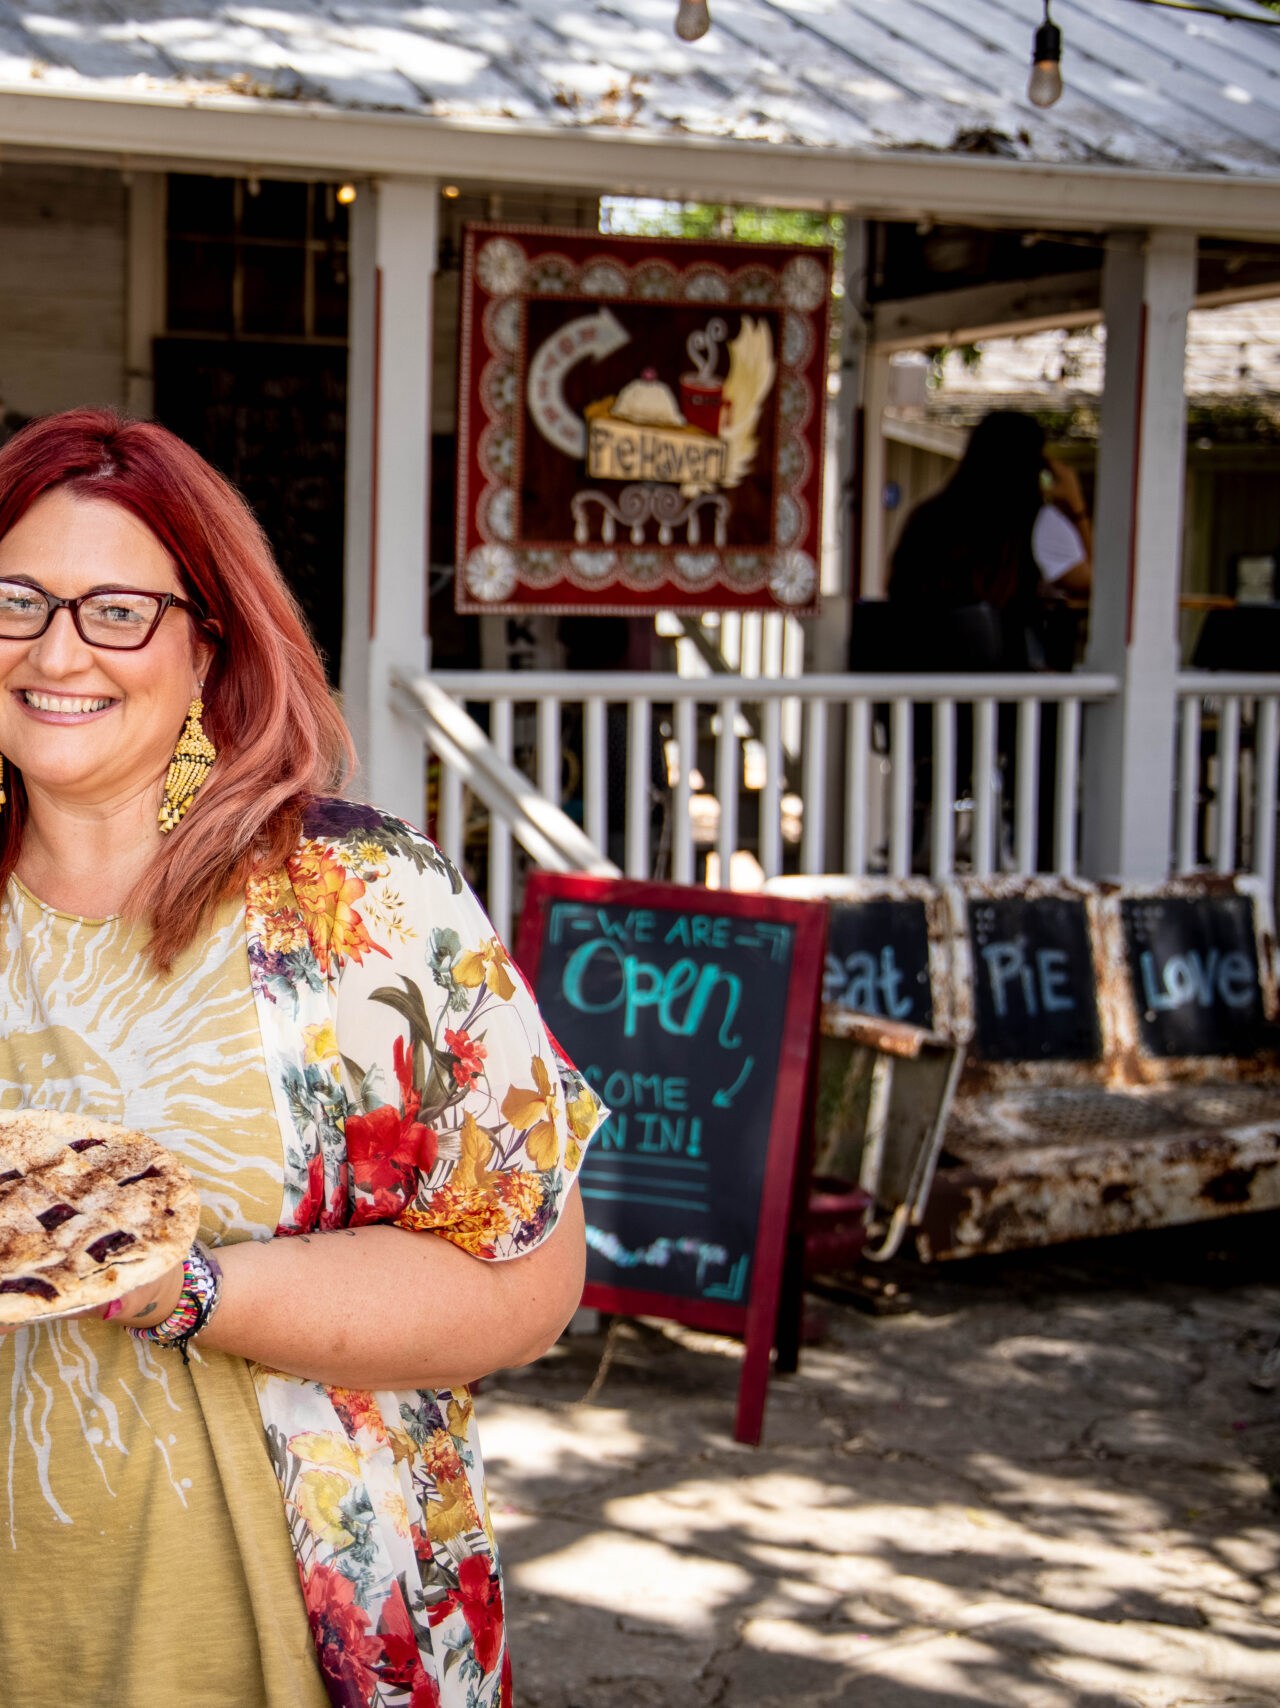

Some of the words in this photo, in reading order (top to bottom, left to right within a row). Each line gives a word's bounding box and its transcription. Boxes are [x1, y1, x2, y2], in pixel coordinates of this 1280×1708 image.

[596, 908, 656, 943] WE
[664, 914, 732, 948] ARE
[562, 937, 742, 1049] Open
[822, 945, 913, 1018] eat
[590, 1112, 628, 1150] N
[634, 1113, 702, 1158] IN!
